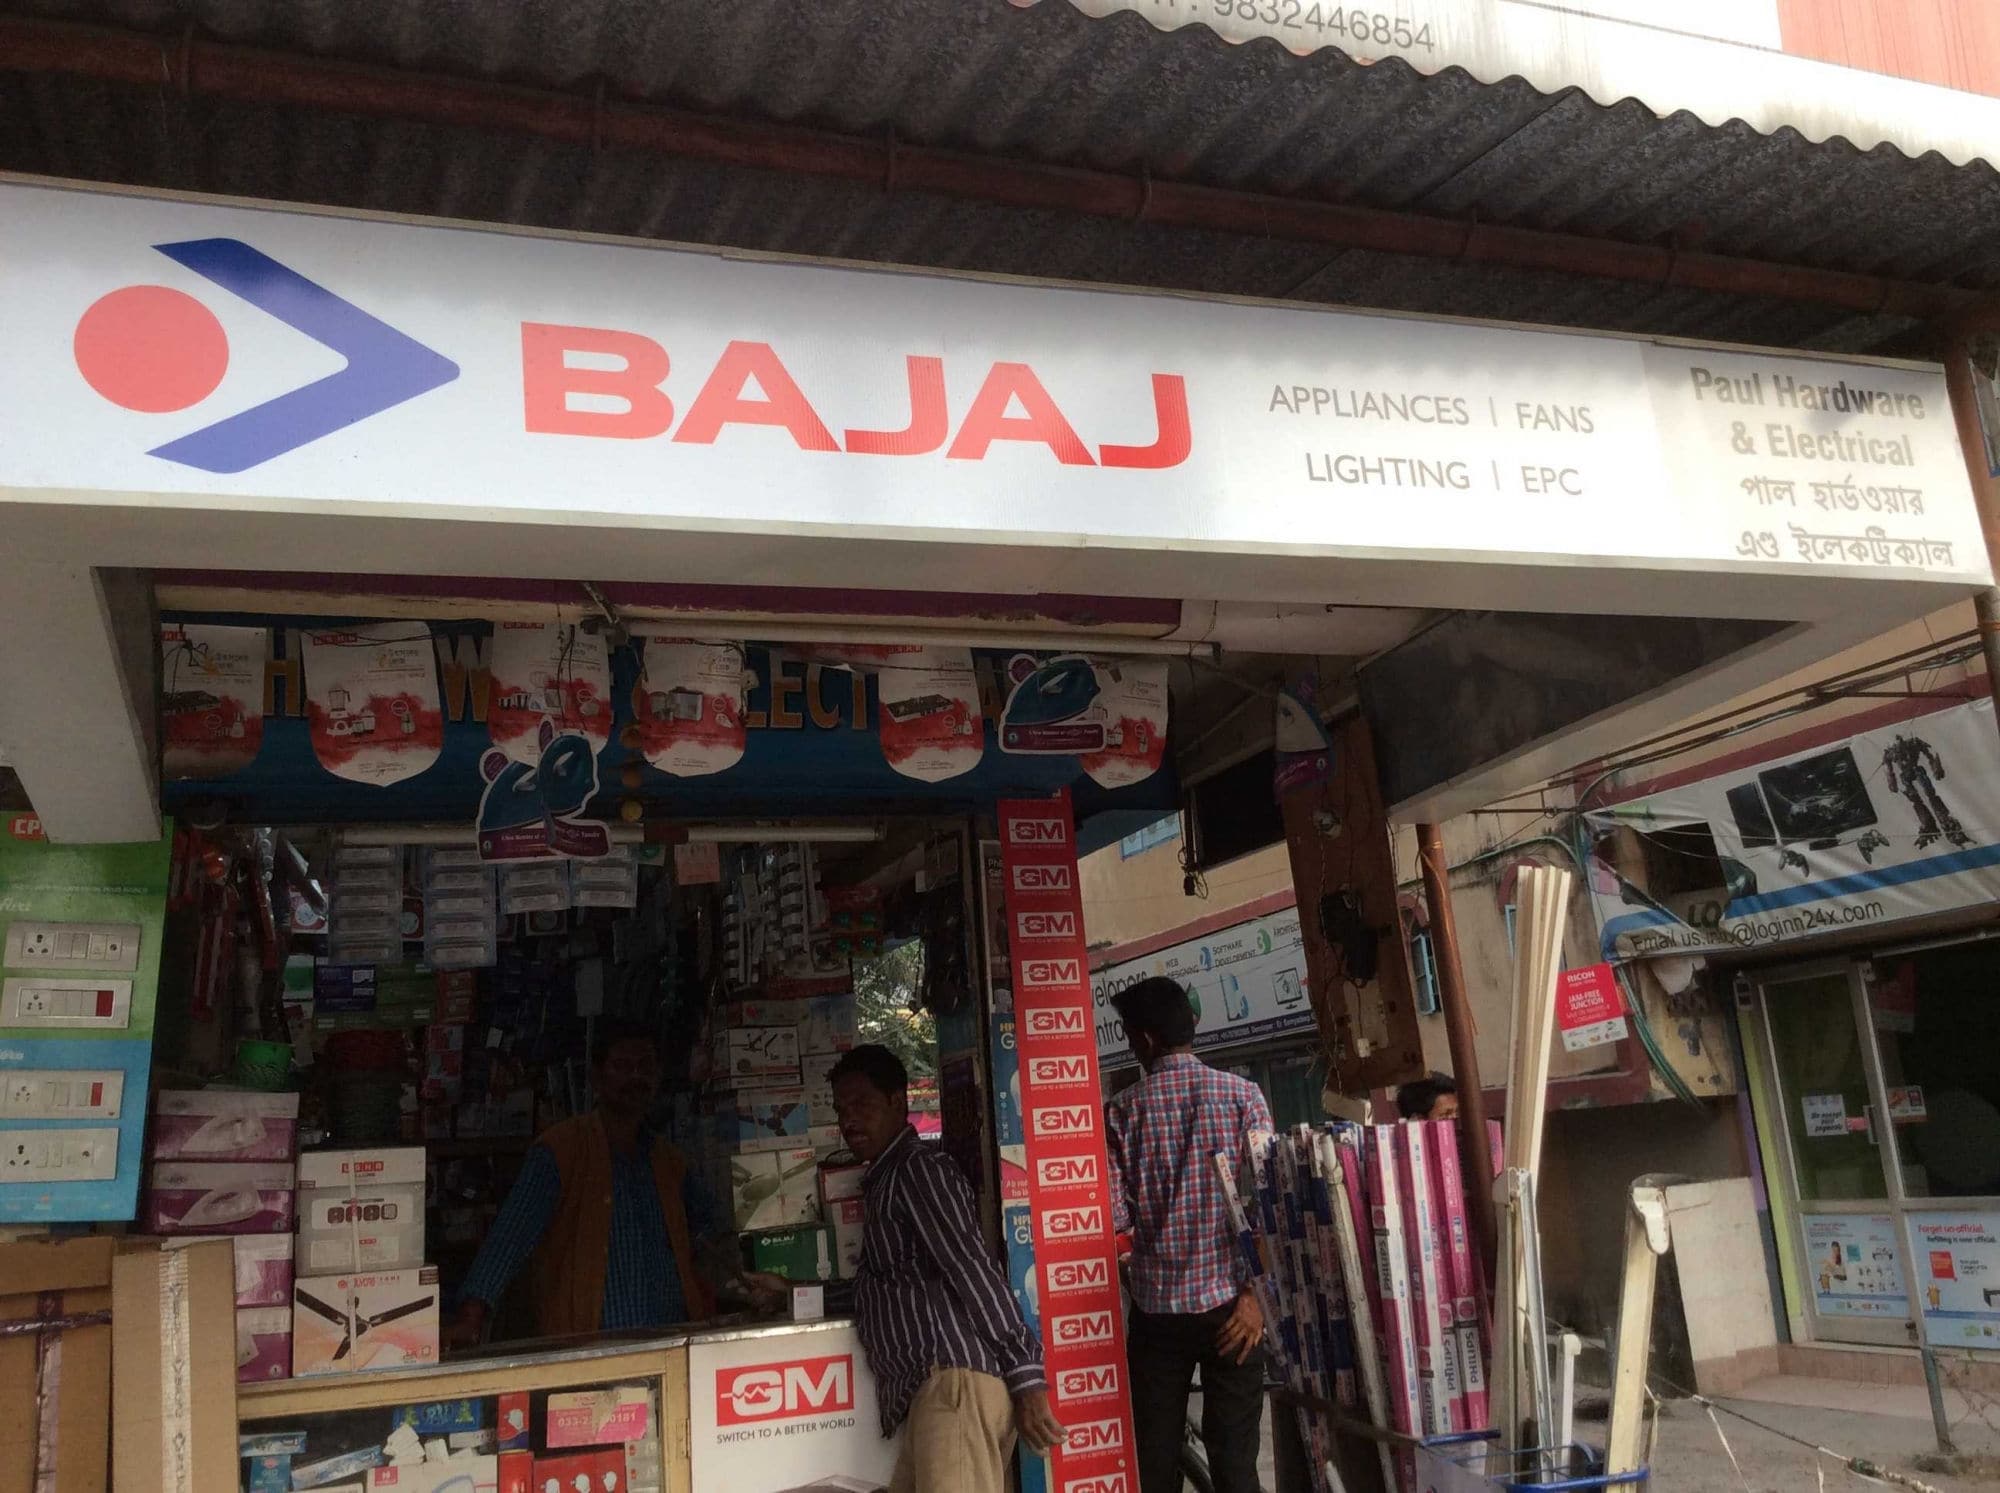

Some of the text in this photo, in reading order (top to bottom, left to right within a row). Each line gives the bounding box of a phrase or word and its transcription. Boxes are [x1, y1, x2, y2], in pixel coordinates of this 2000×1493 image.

[520, 320, 1193, 469] BAJAJ
[1689, 366, 1926, 420] Paul Hardware
[1268, 384, 1595, 434] APPLIANCES FANS
[1730, 420, 1915, 467] & Electrical
[1305, 452, 1583, 496] LIGHTING EPC
[1740, 474, 1797, 507] পাল
[14, 818, 45, 835] CP
[1012, 821, 1063, 839] GM
[1017, 867, 1068, 887] GM
[1021, 915, 1073, 934] GM
[1025, 962, 1077, 981] GM
[1567, 970, 1595, 983] RICOH
[1028, 1010, 1082, 1031] GM
[1032, 1059, 1086, 1080] GM
[1036, 1108, 1090, 1130] GM
[1041, 1159, 1095, 1181] GM
[1045, 1210, 1100, 1234] GM
[1050, 1262, 1105, 1287] GM
[1378, 1239, 1393, 1292] PHILIPS
[1055, 1314, 1110, 1340] GM
[1442, 1338, 1457, 1391] PHILIPS
[1464, 1330, 1480, 1384] PHILIPS
[721, 1361, 849, 1417] GM
[1060, 1367, 1115, 1394] GM
[716, 1417, 856, 1444] SWITCH TO A BETTER WORLD
[1068, 1422, 1120, 1449] GM
